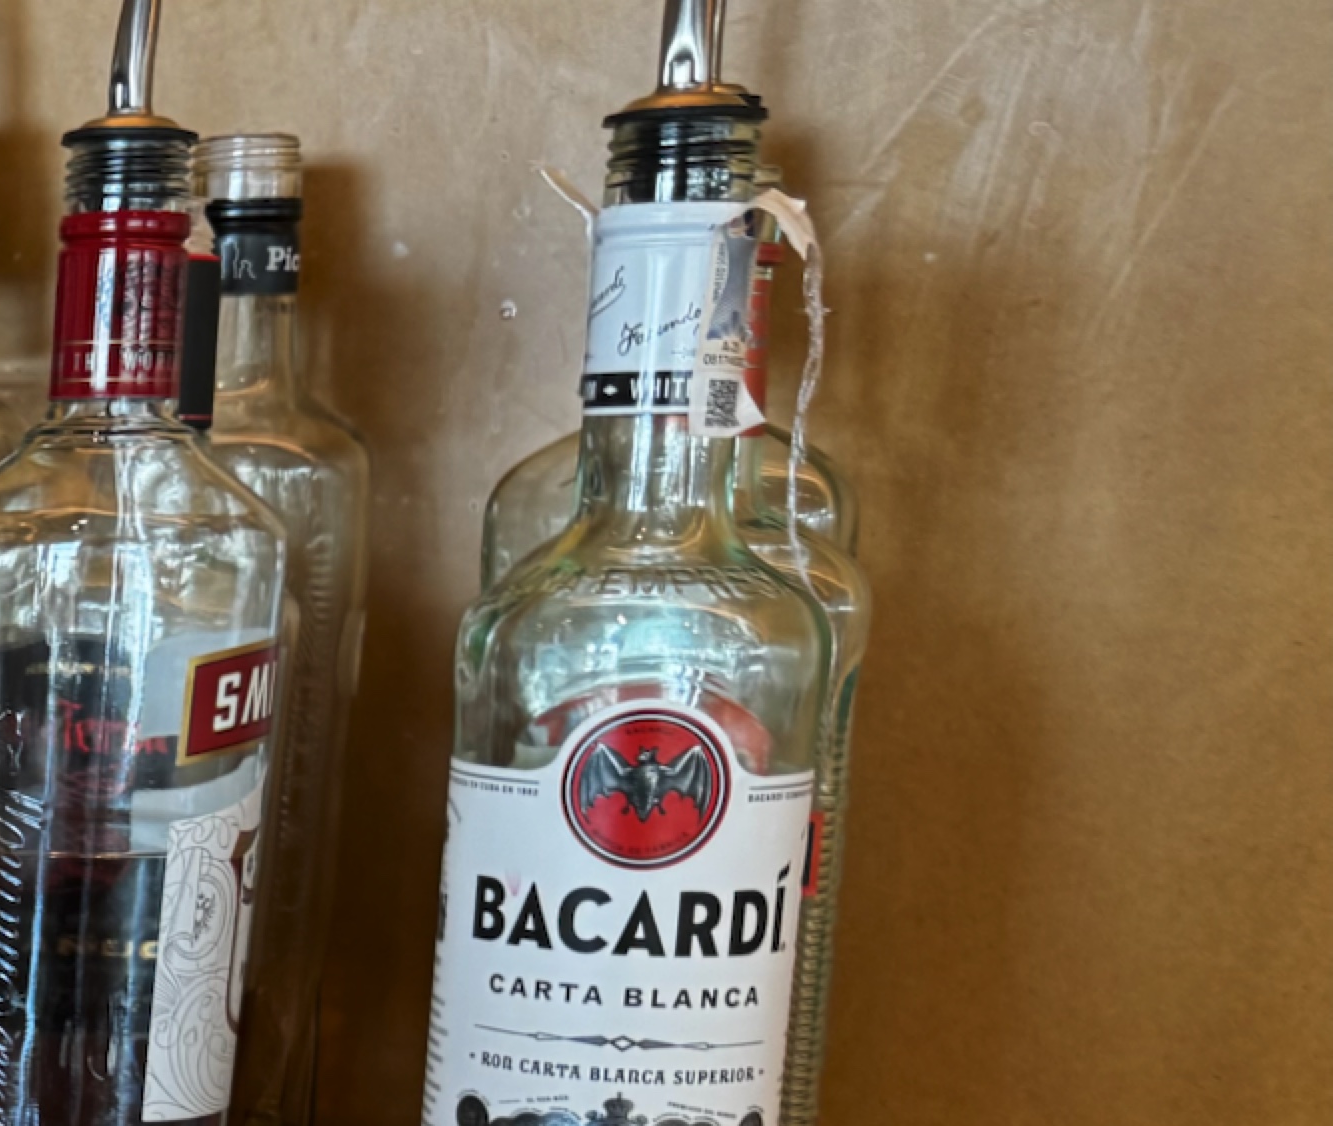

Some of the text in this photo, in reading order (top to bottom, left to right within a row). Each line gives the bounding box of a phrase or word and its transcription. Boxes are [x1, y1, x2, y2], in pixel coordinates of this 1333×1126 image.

[472, 862, 791, 959] BACARDÍ
[489, 974, 760, 1009] CARTA BLANCA
[519, 1058, 581, 1081] CARTA
[589, 1066, 666, 1086] BLANCA
[674, 1065, 755, 1086] SUPERIOR
